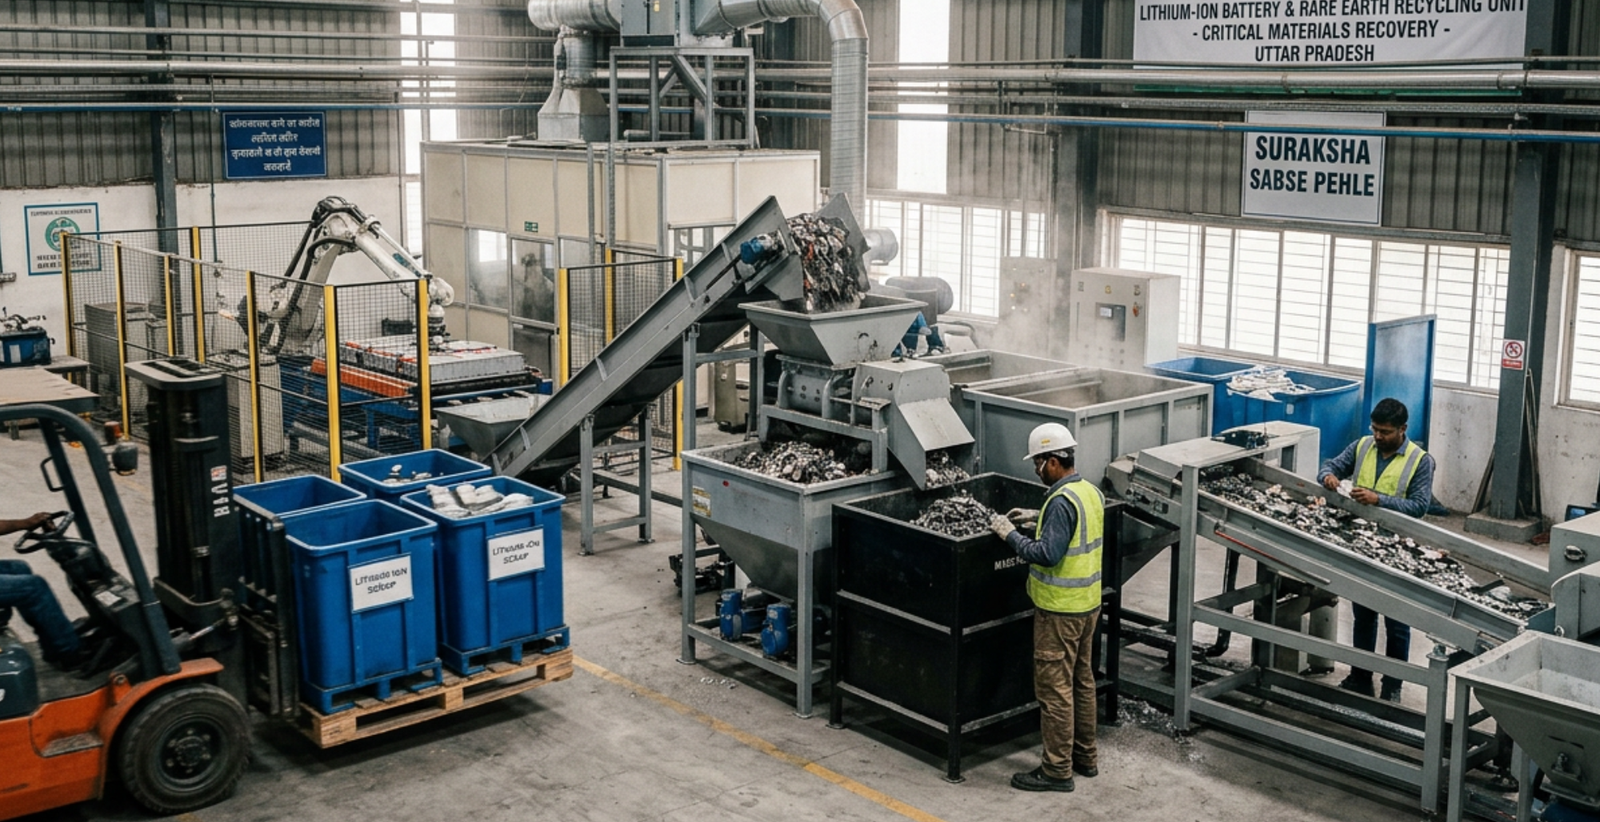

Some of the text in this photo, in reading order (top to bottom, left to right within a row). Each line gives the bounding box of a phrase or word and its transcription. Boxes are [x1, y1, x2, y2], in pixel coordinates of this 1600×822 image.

[1140, 3, 1218, 21] LITHIUM-ION
[1222, 1, 1281, 19] BATTERY
[1285, 0, 1295, 17] &
[1299, 0, 1337, 17] RARE
[1341, 0, 1389, 16] EARTH
[1394, 0, 1482, 14] RECYCLING
[1202, 24, 1263, 41] CRITICAL
[1268, 22, 1350, 40] MATERIALS
[1355, 19, 1439, 38] RECOVERY
[1255, 44, 1375, 62] UTTAR PRADESH
[1255, 135, 1371, 165] SURAKSHA
[1250, 168, 1375, 197] SABSE PEHLE
